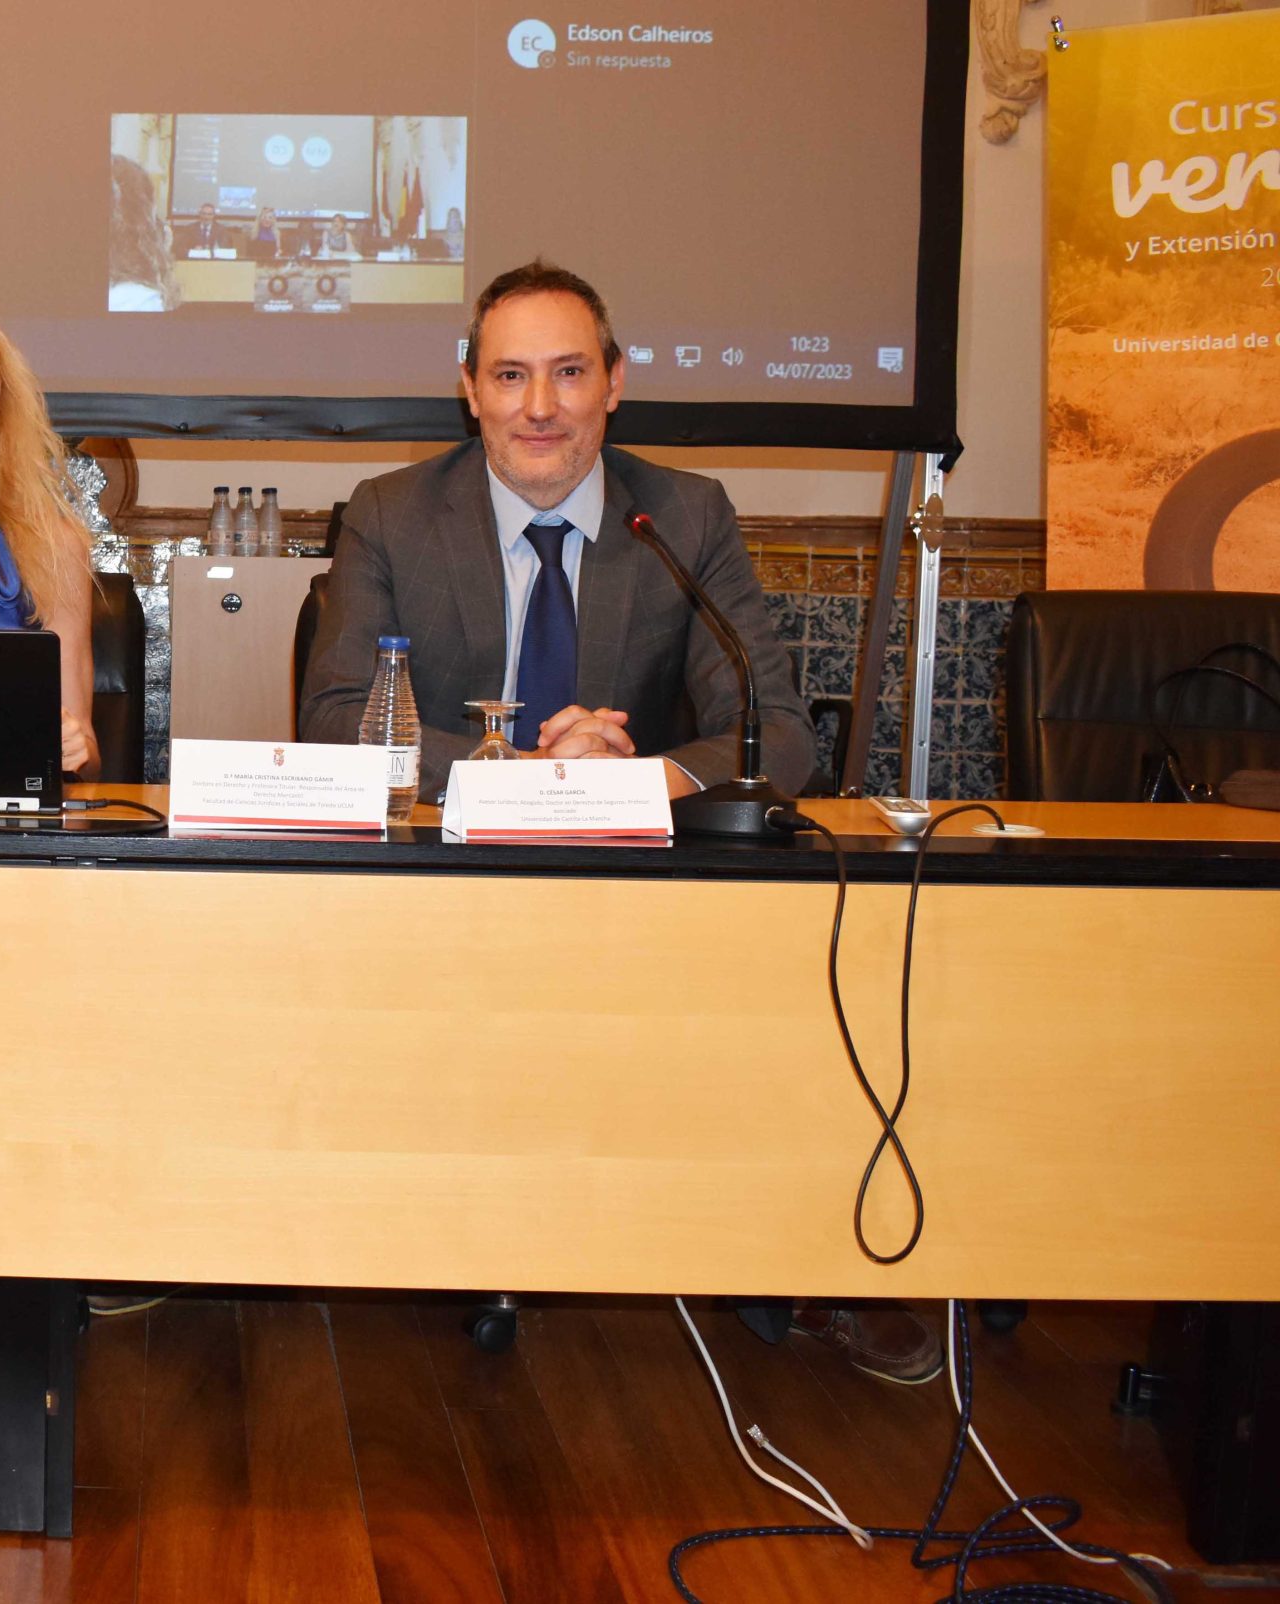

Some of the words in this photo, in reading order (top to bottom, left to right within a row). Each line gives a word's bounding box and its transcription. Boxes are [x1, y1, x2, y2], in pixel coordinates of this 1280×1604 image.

[521, 36, 543, 51] EC
[568, 24, 623, 41] Edson
[628, 25, 713, 44] Calheiros
[567, 51, 590, 66] Sin
[596, 54, 672, 70] respuesta
[1125, 241, 1140, 262] y
[1148, 229, 1275, 255] Extensión
[1261, 267, 1280, 287] 2
[790, 336, 829, 352] 10:23
[1113, 333, 1237, 353] Universidad
[1243, 332, 1269, 349] de
[766, 362, 852, 379] 04/07/2023
